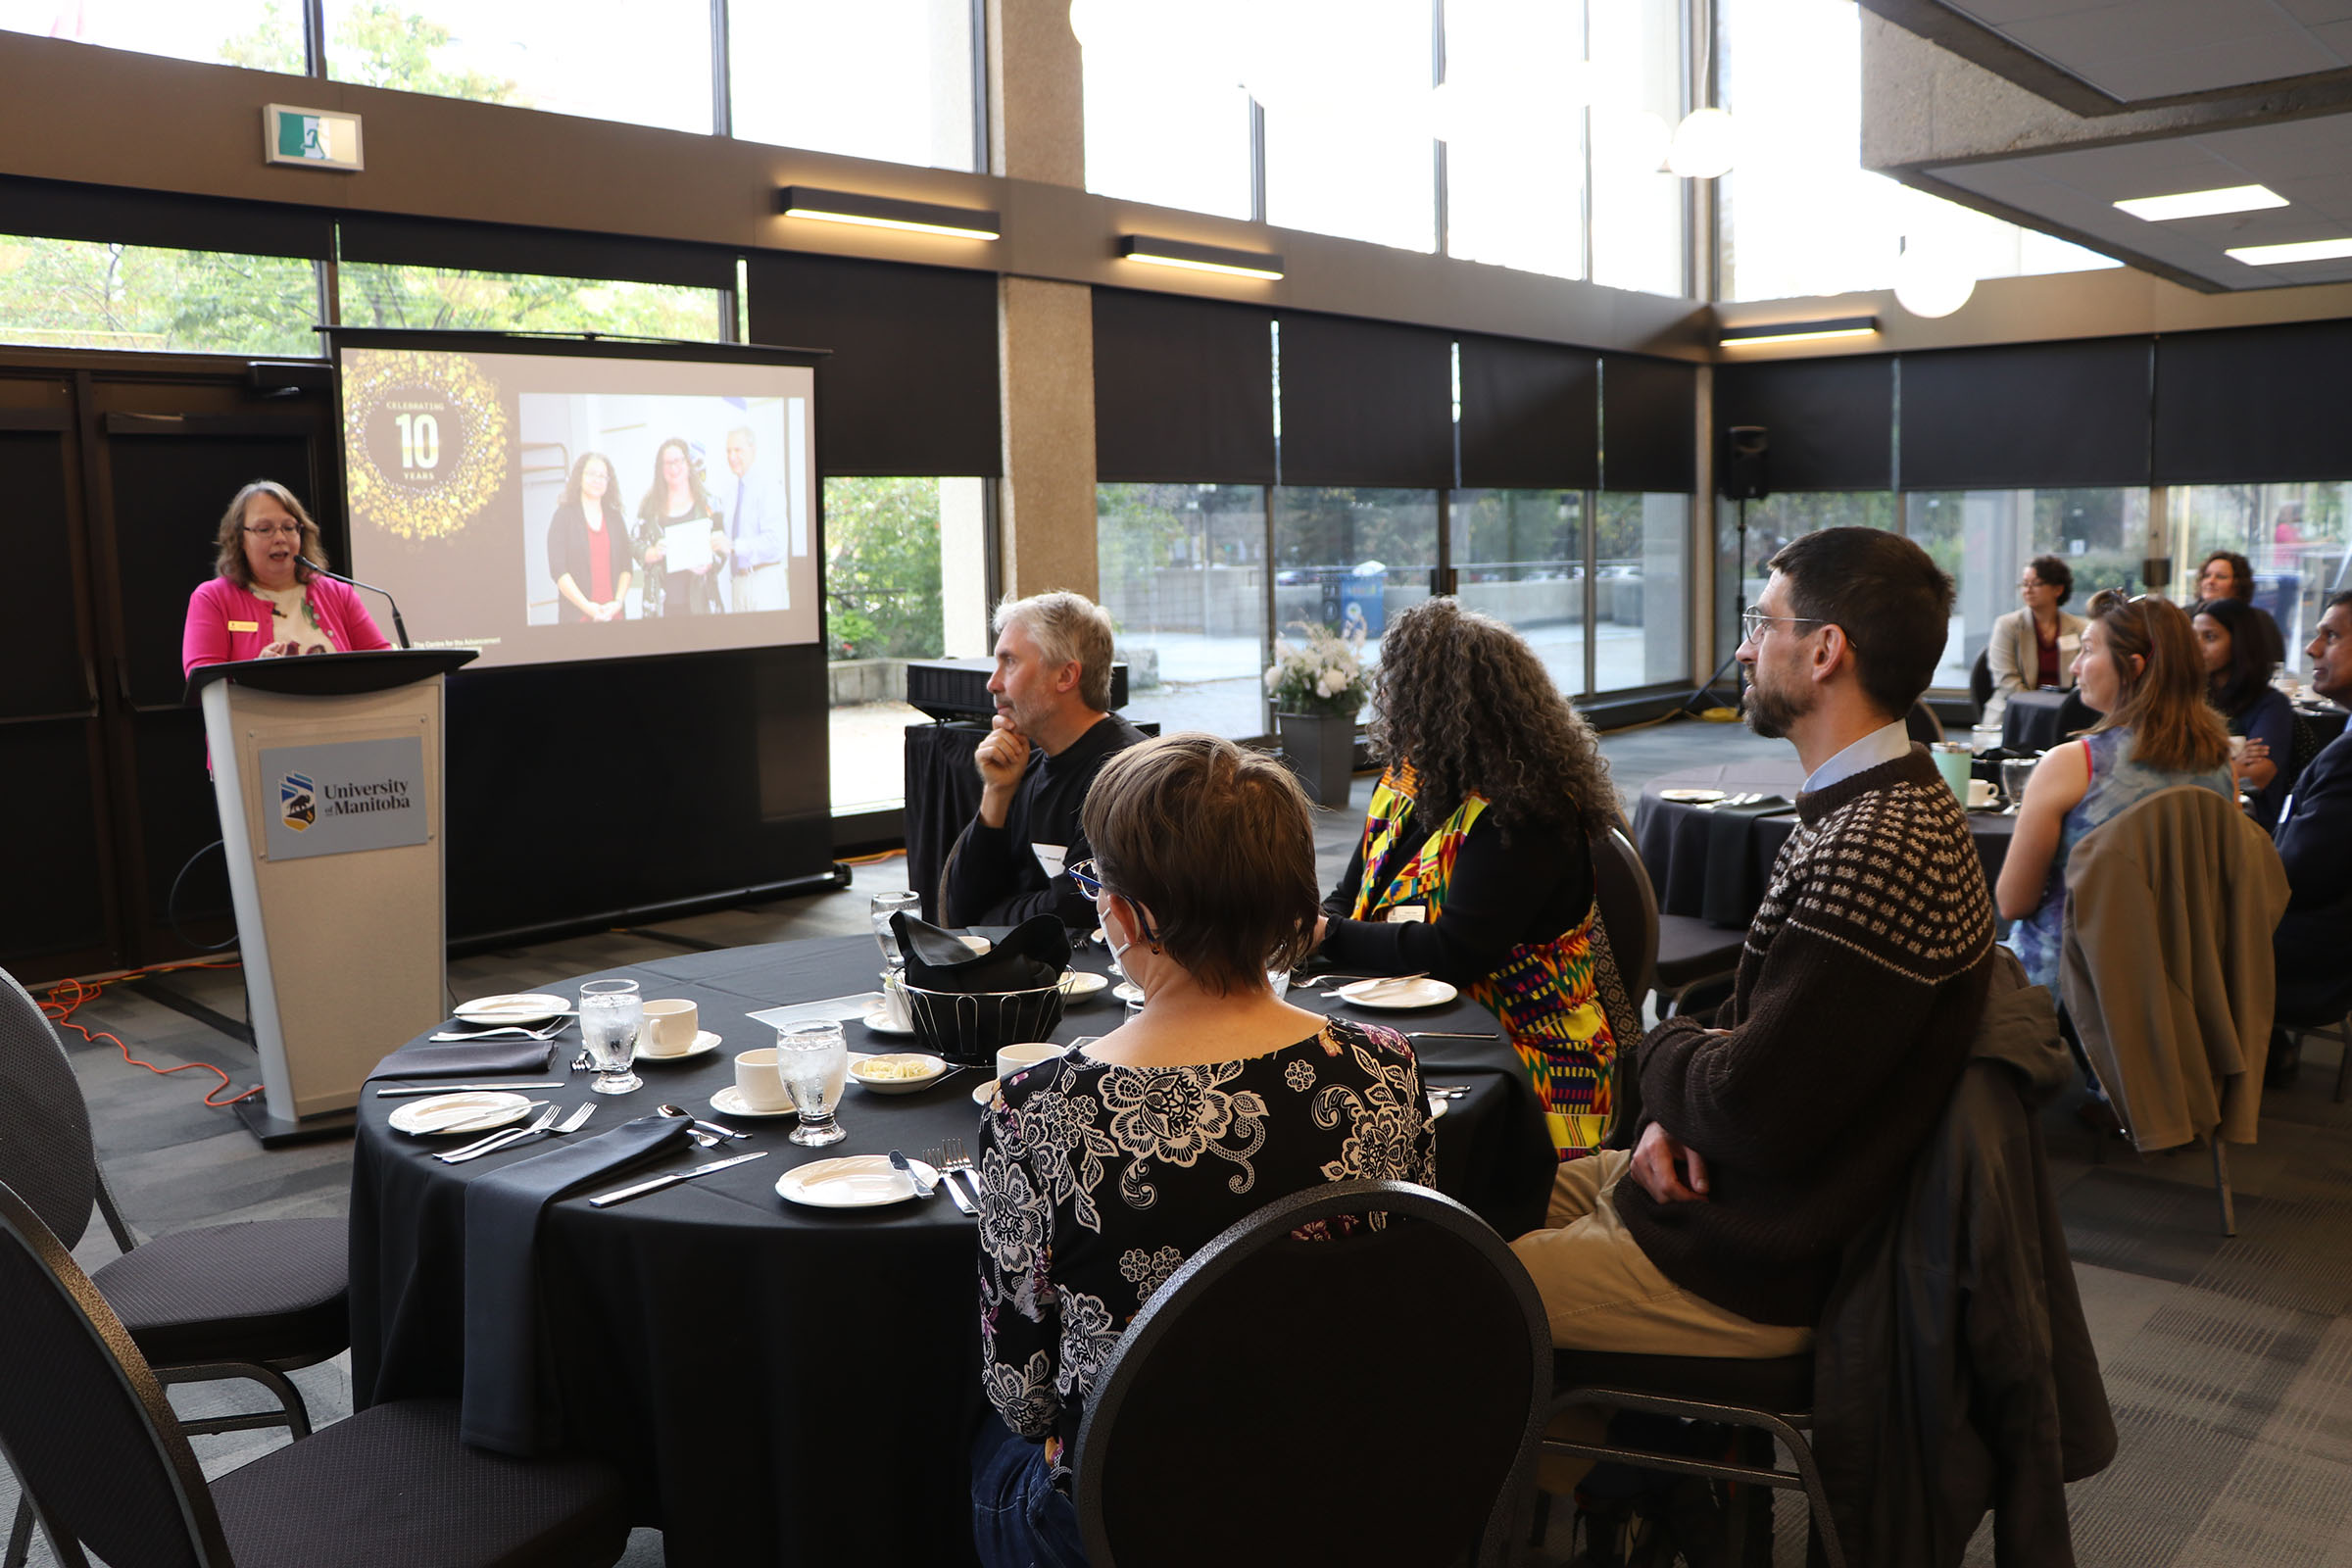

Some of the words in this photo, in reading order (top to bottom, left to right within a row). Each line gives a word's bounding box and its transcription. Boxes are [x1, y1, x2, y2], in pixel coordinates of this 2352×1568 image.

[386, 401, 445, 411] CELEBRATING
[395, 413, 439, 468] 10
[403, 471, 435, 480] YEARS
[324, 779, 408, 799] University
[324, 806, 333, 816] of
[334, 795, 410, 815] Manitoba
